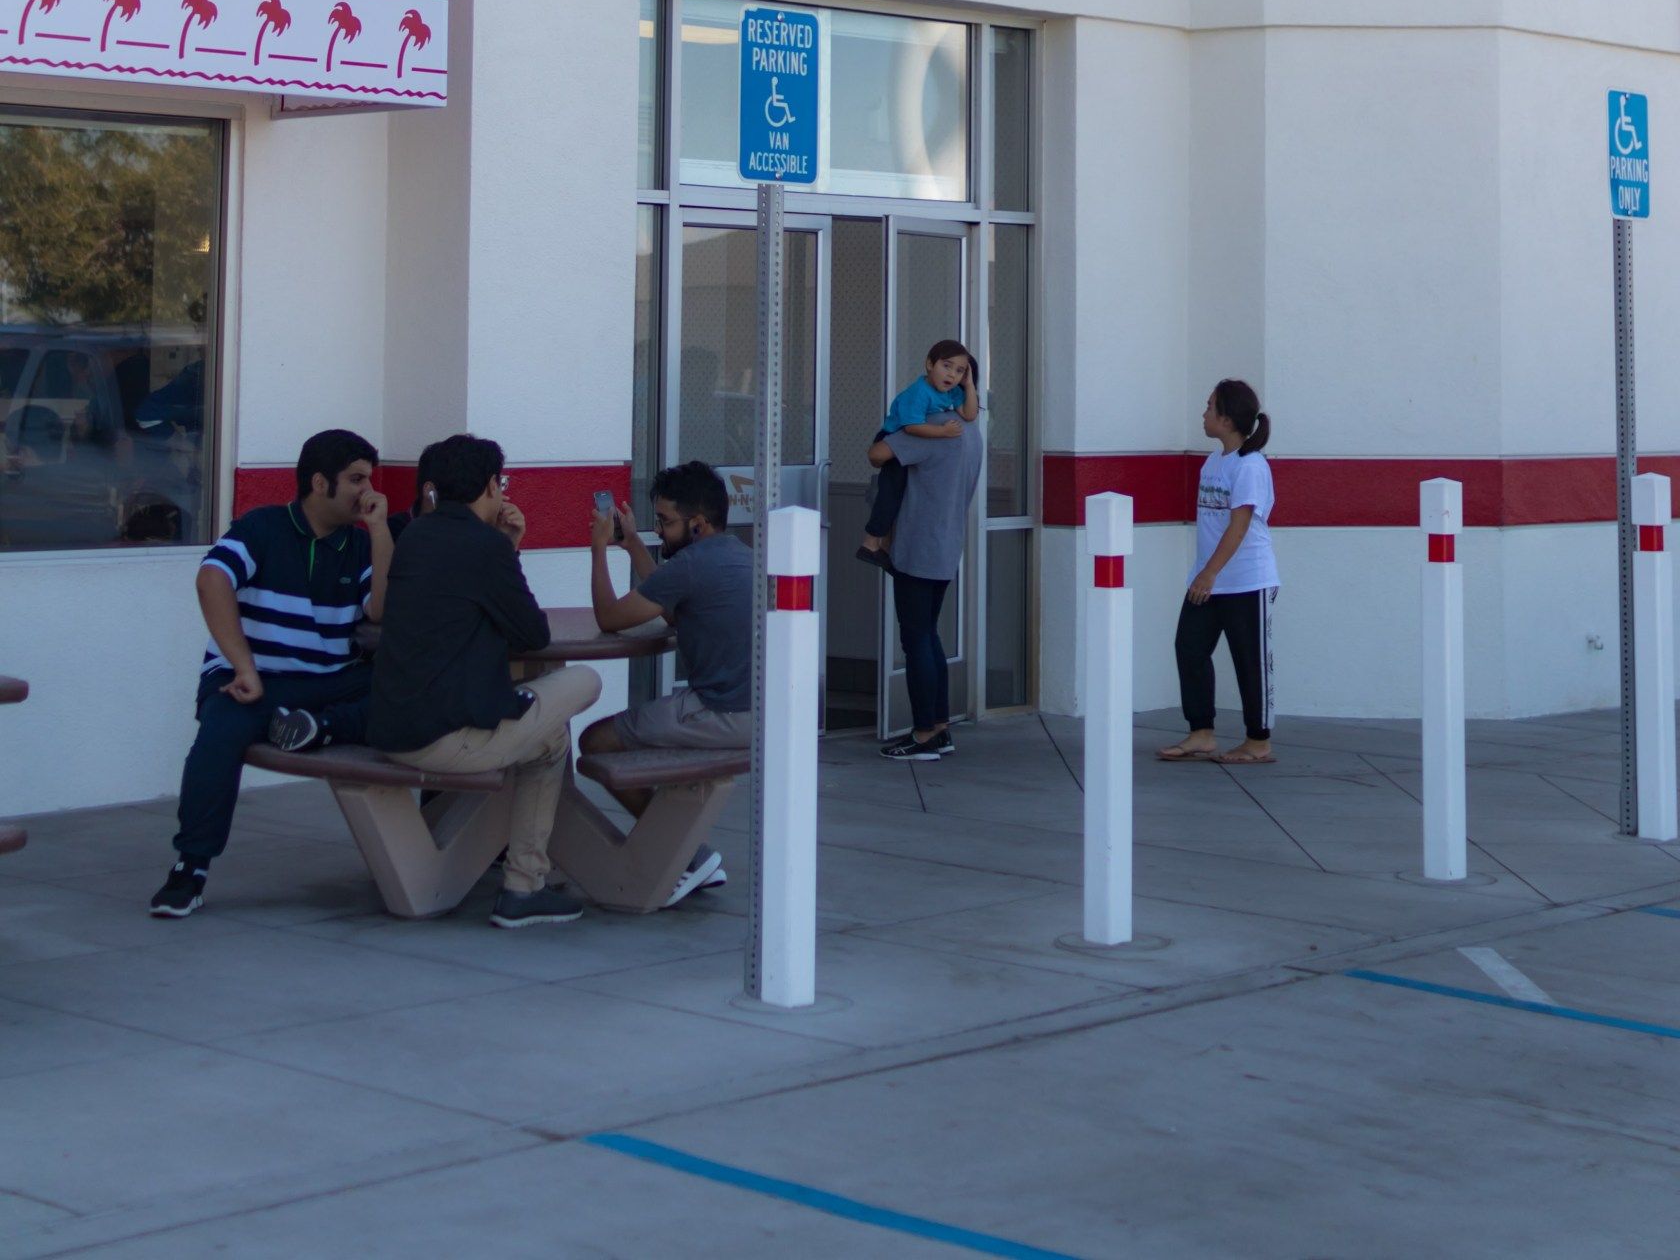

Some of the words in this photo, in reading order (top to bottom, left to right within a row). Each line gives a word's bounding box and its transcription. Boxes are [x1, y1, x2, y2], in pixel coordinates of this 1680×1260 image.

[747, 18, 813, 49] RESERVED
[752, 47, 808, 77] PARKING
[768, 130, 790, 151] VAN
[748, 151, 808, 175] ACCESSIBLE
[1610, 155, 1648, 184] PARKING
[1618, 184, 1641, 212] ONLY
